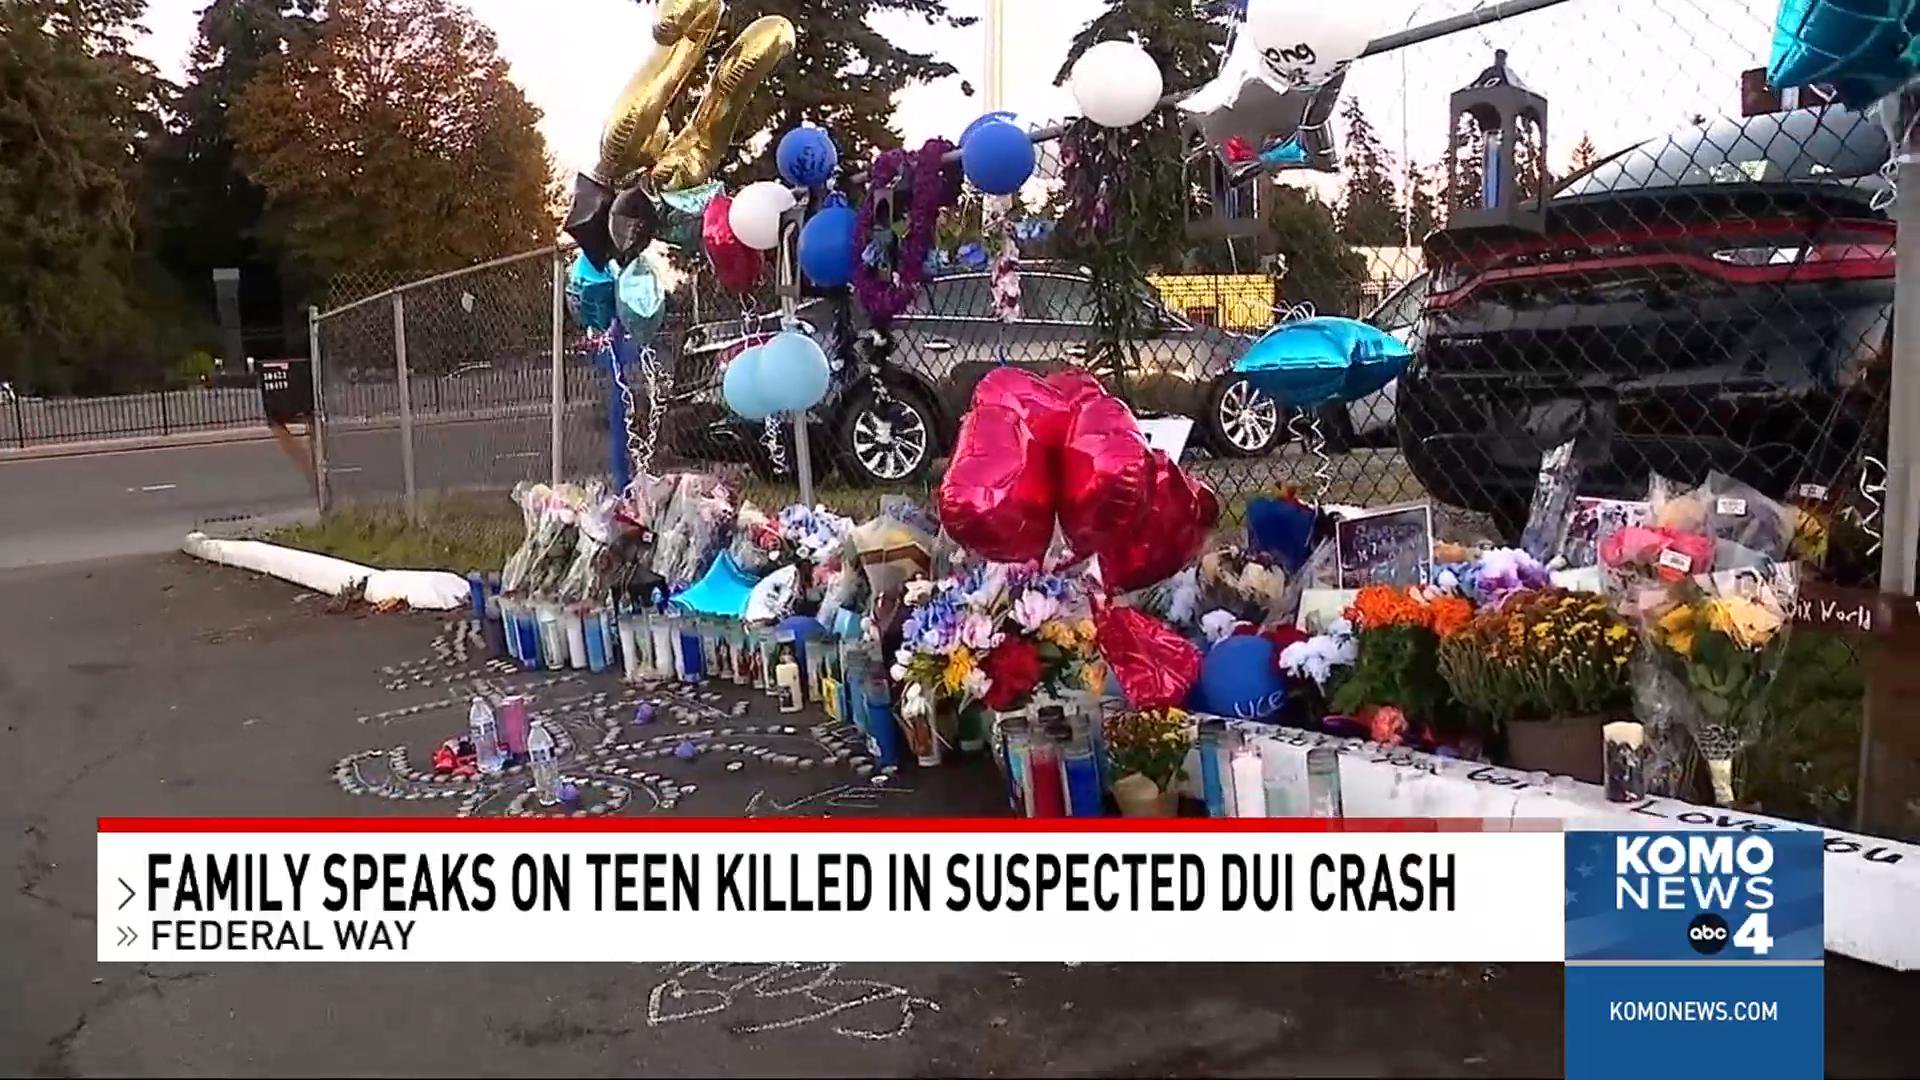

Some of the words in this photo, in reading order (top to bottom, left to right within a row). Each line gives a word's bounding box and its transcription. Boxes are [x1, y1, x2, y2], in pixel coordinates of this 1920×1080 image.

[1259, 43, 1317, 66] ong
[1820, 600, 1872, 631] World
[1822, 836, 1904, 865] ou
